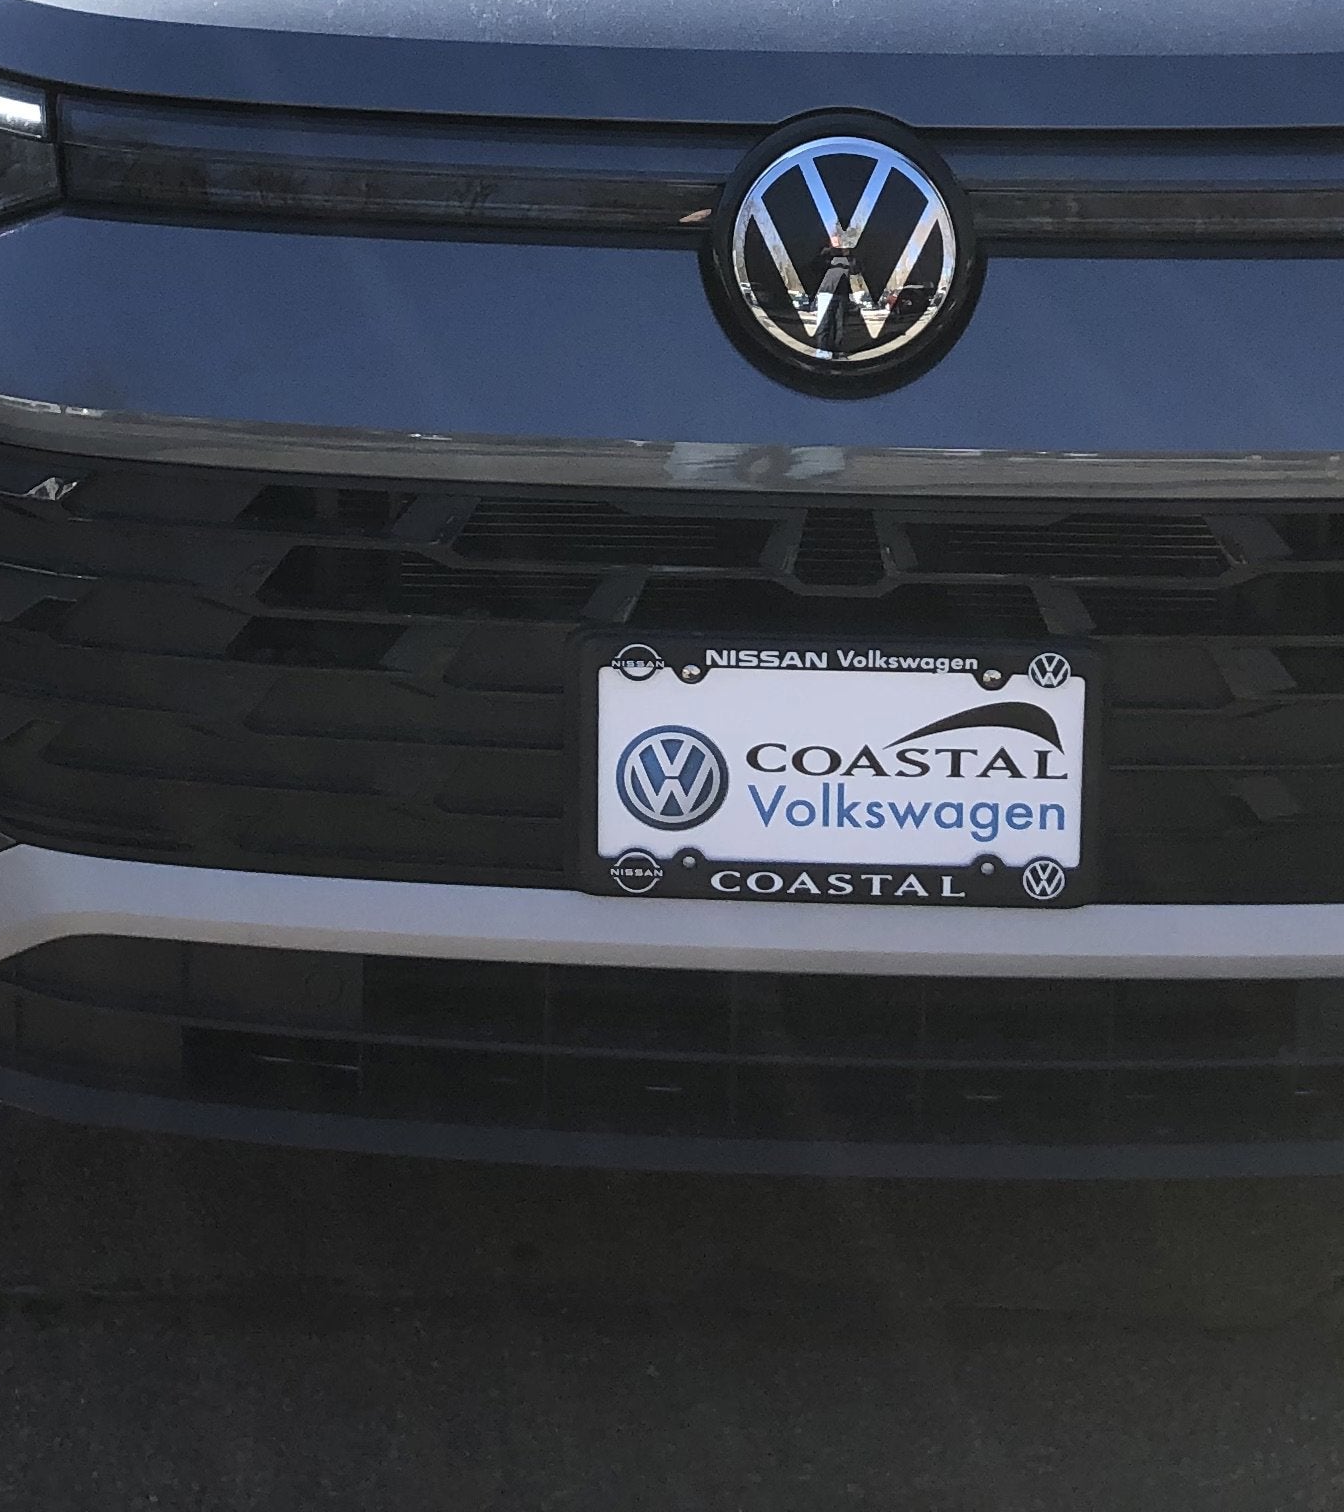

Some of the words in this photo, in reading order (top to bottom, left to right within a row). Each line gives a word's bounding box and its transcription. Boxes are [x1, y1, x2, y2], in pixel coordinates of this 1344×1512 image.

[736, 143, 953, 354] VW
[611, 659, 665, 668] NISSAN
[705, 649, 828, 669] NISSAN
[836, 649, 979, 674] Volkswagen
[746, 742, 1068, 780] COASTAL
[623, 732, 722, 827] VW
[747, 782, 1066, 842] Volkswagen
[610, 868, 663, 877] NISSAN
[710, 870, 966, 899] COASTAL
